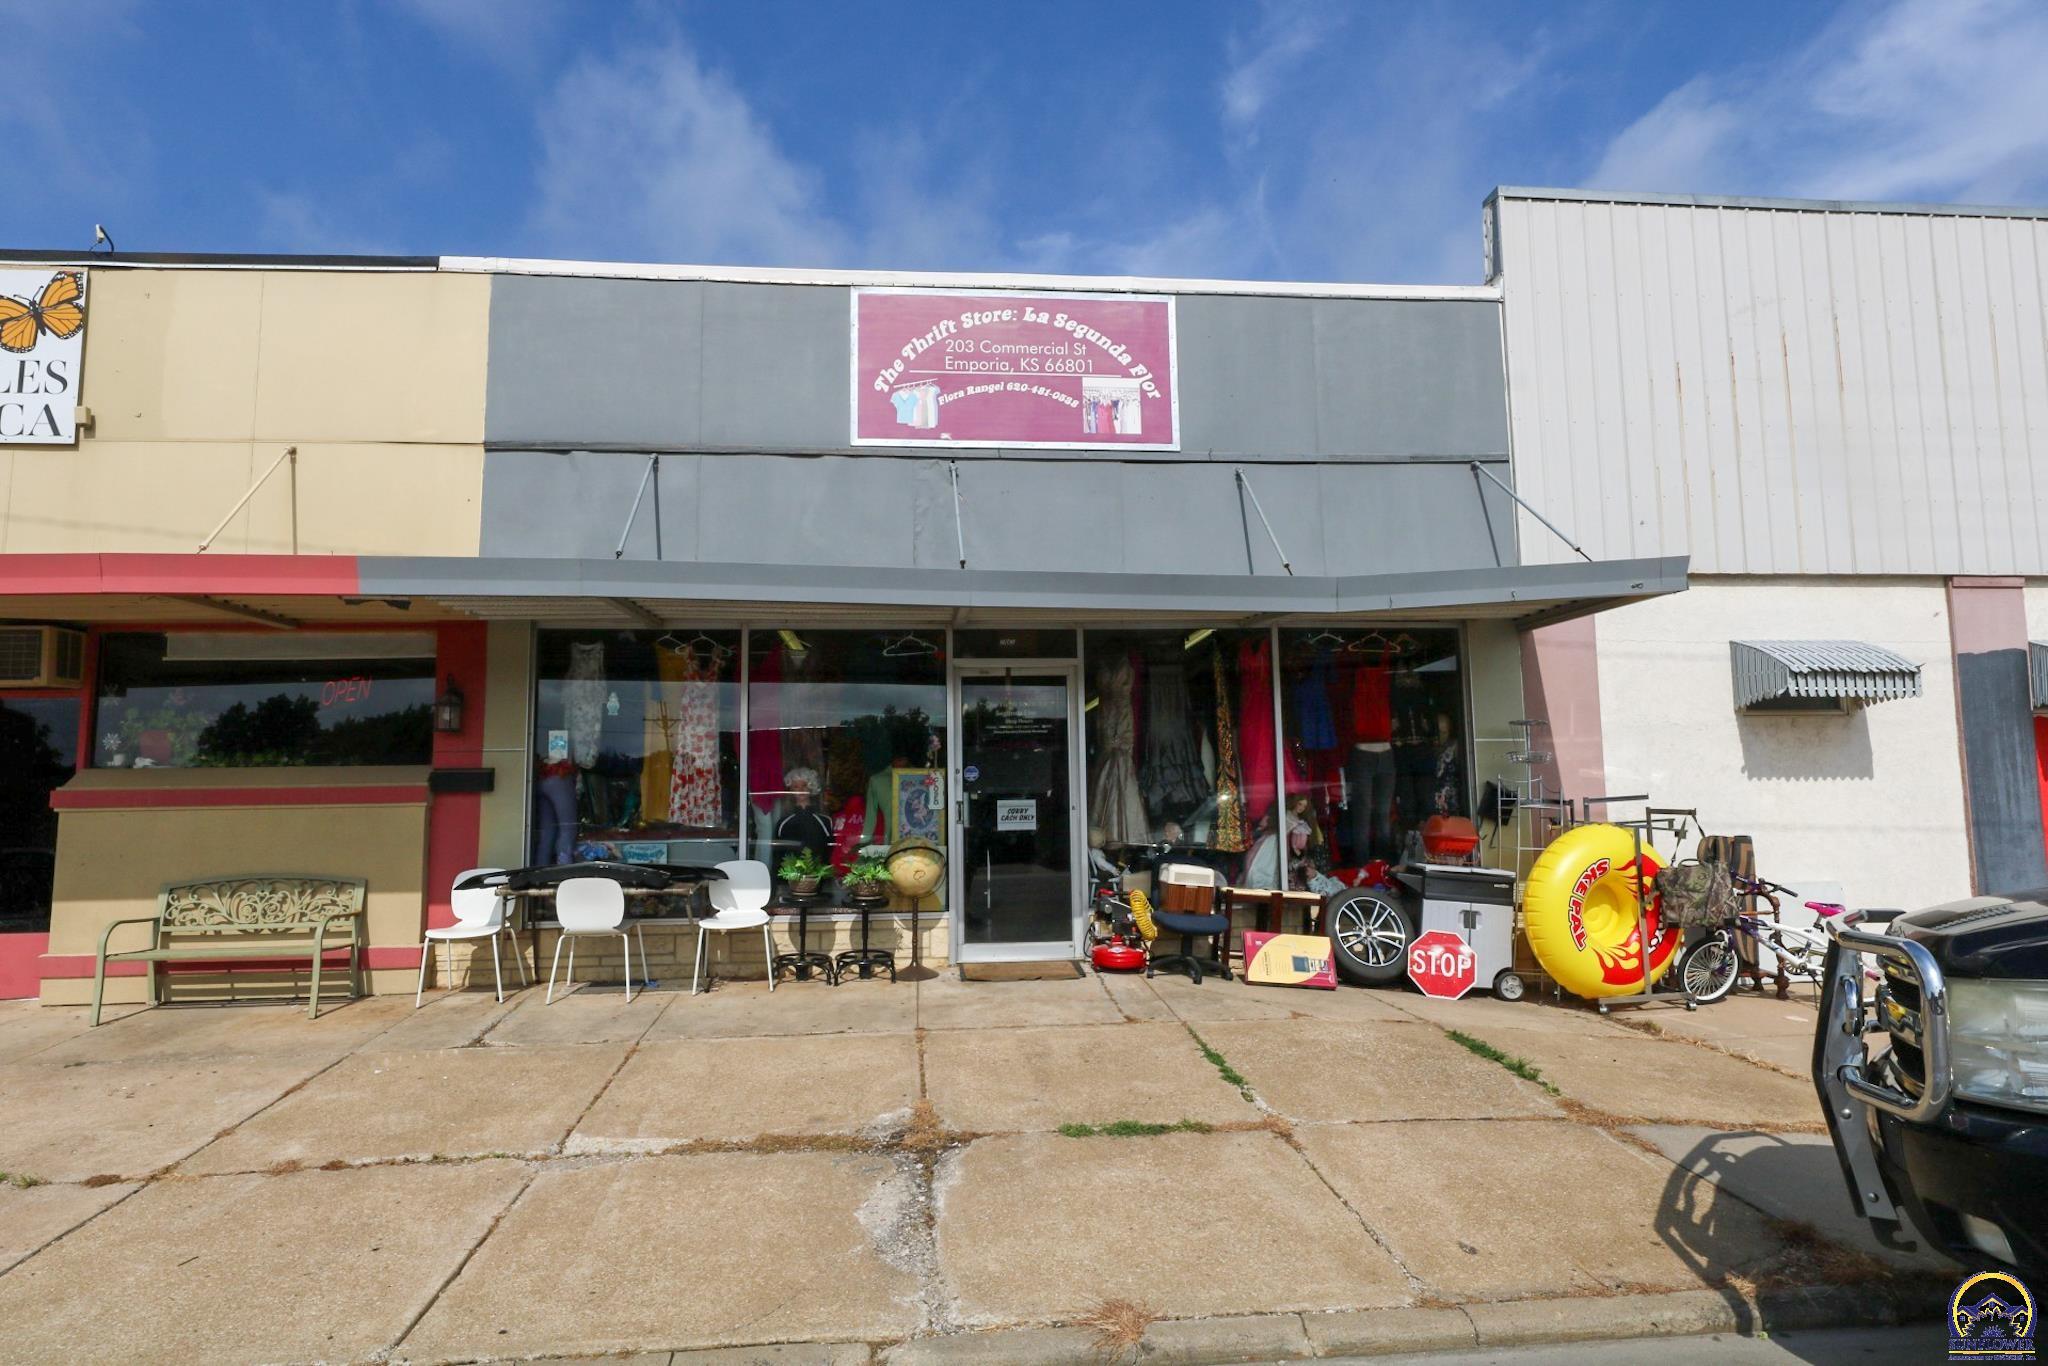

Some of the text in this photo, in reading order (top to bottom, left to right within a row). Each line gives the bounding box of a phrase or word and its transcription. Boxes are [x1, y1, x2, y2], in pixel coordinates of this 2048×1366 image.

[874, 306, 1161, 400] The Thrift Store: La Segunda Flor
[945, 340, 1087, 356] 203 Commercial St
[945, 356, 1094, 374] Emporia, KS 66801
[937, 389, 965, 406] Flora
[966, 381, 1004, 396] Rangel
[322, 673, 373, 706] OPEN
[1007, 807, 1029, 815] SORRY
[1569, 896, 1587, 952] PAL
[1411, 949, 1472, 979] STOP
